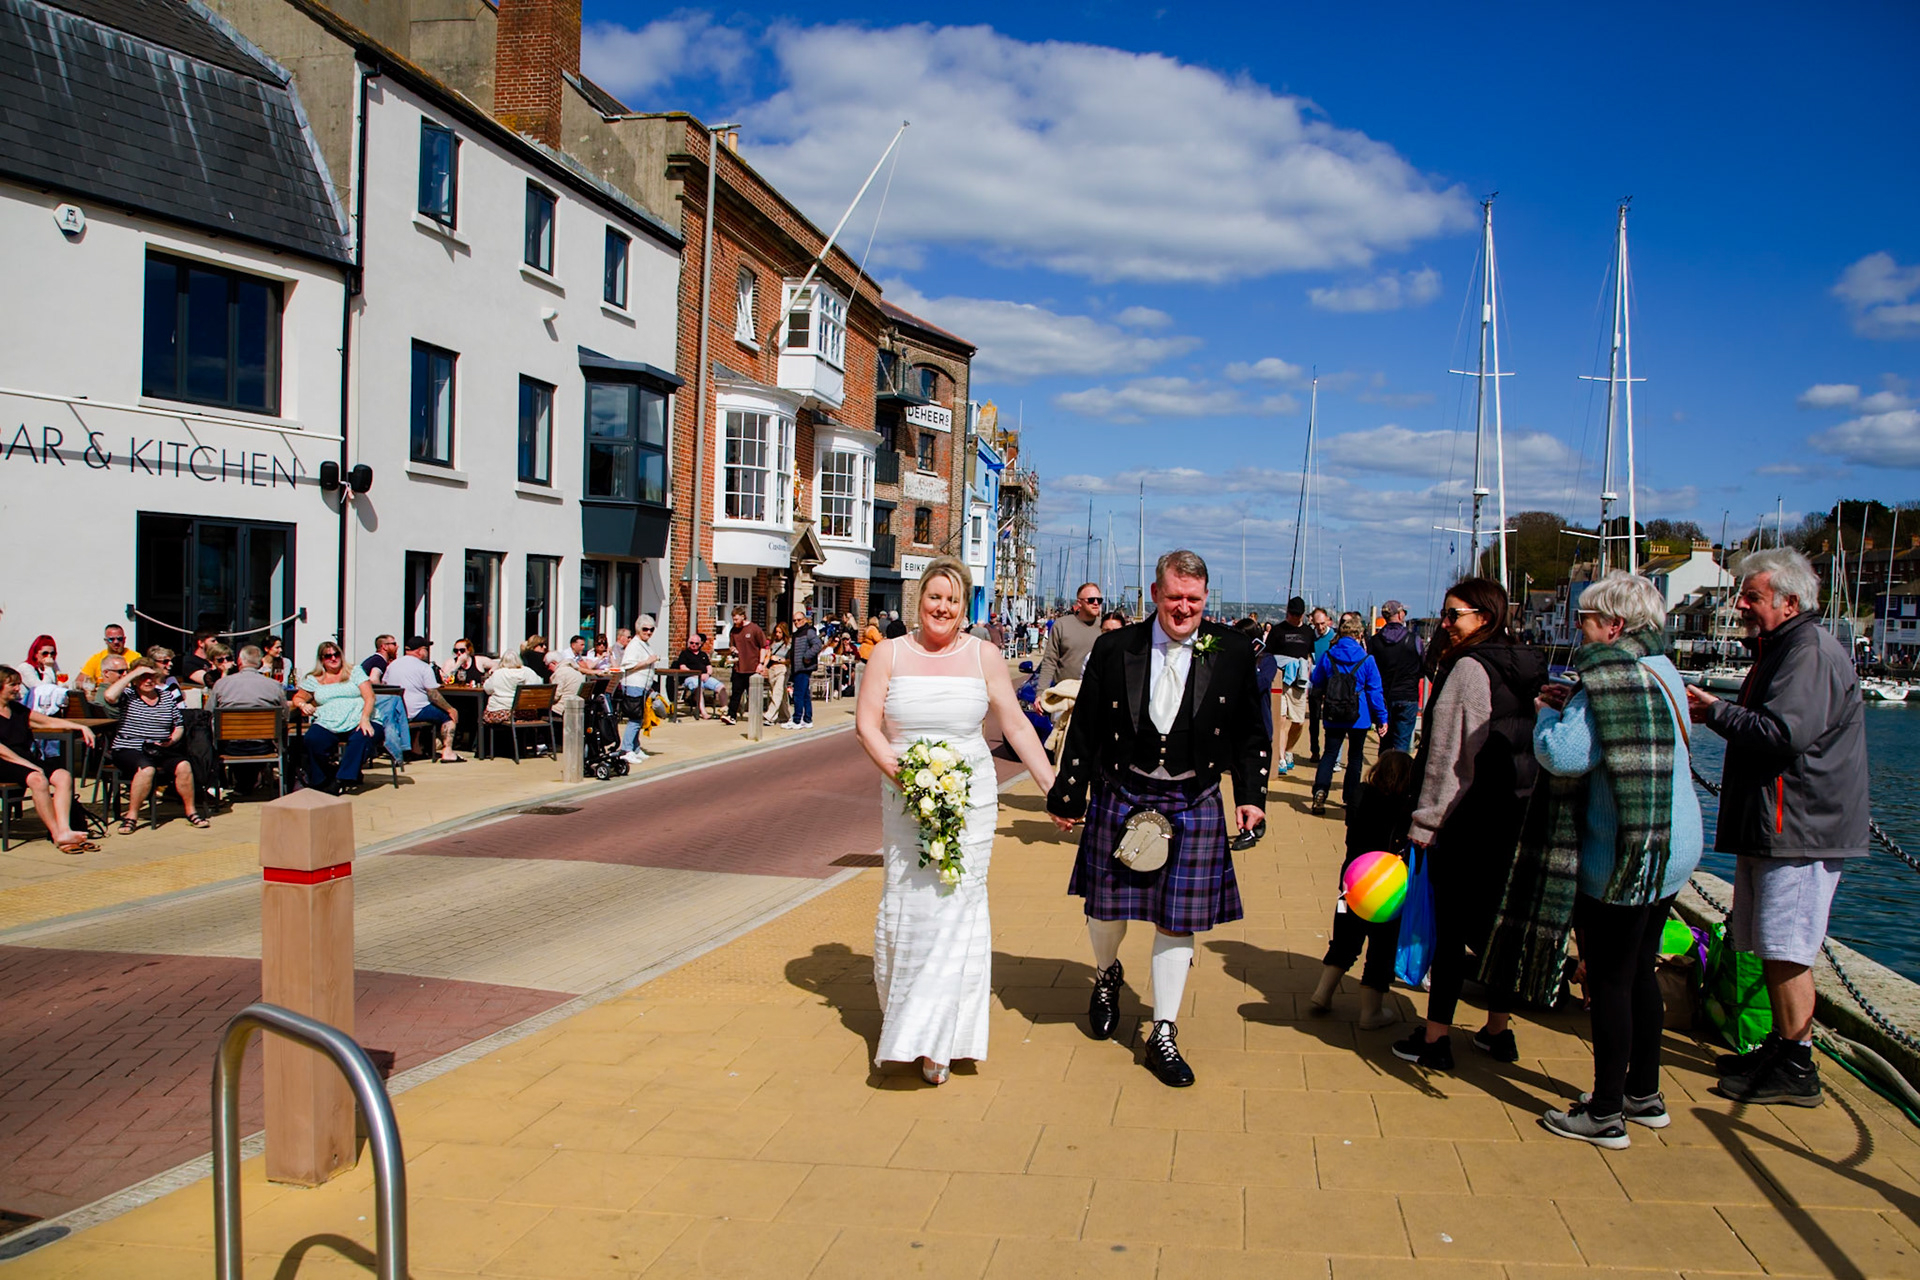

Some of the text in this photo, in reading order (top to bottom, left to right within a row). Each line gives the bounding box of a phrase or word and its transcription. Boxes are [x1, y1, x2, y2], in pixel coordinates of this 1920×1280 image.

[0, 423, 297, 489] AR & KITCHEN
